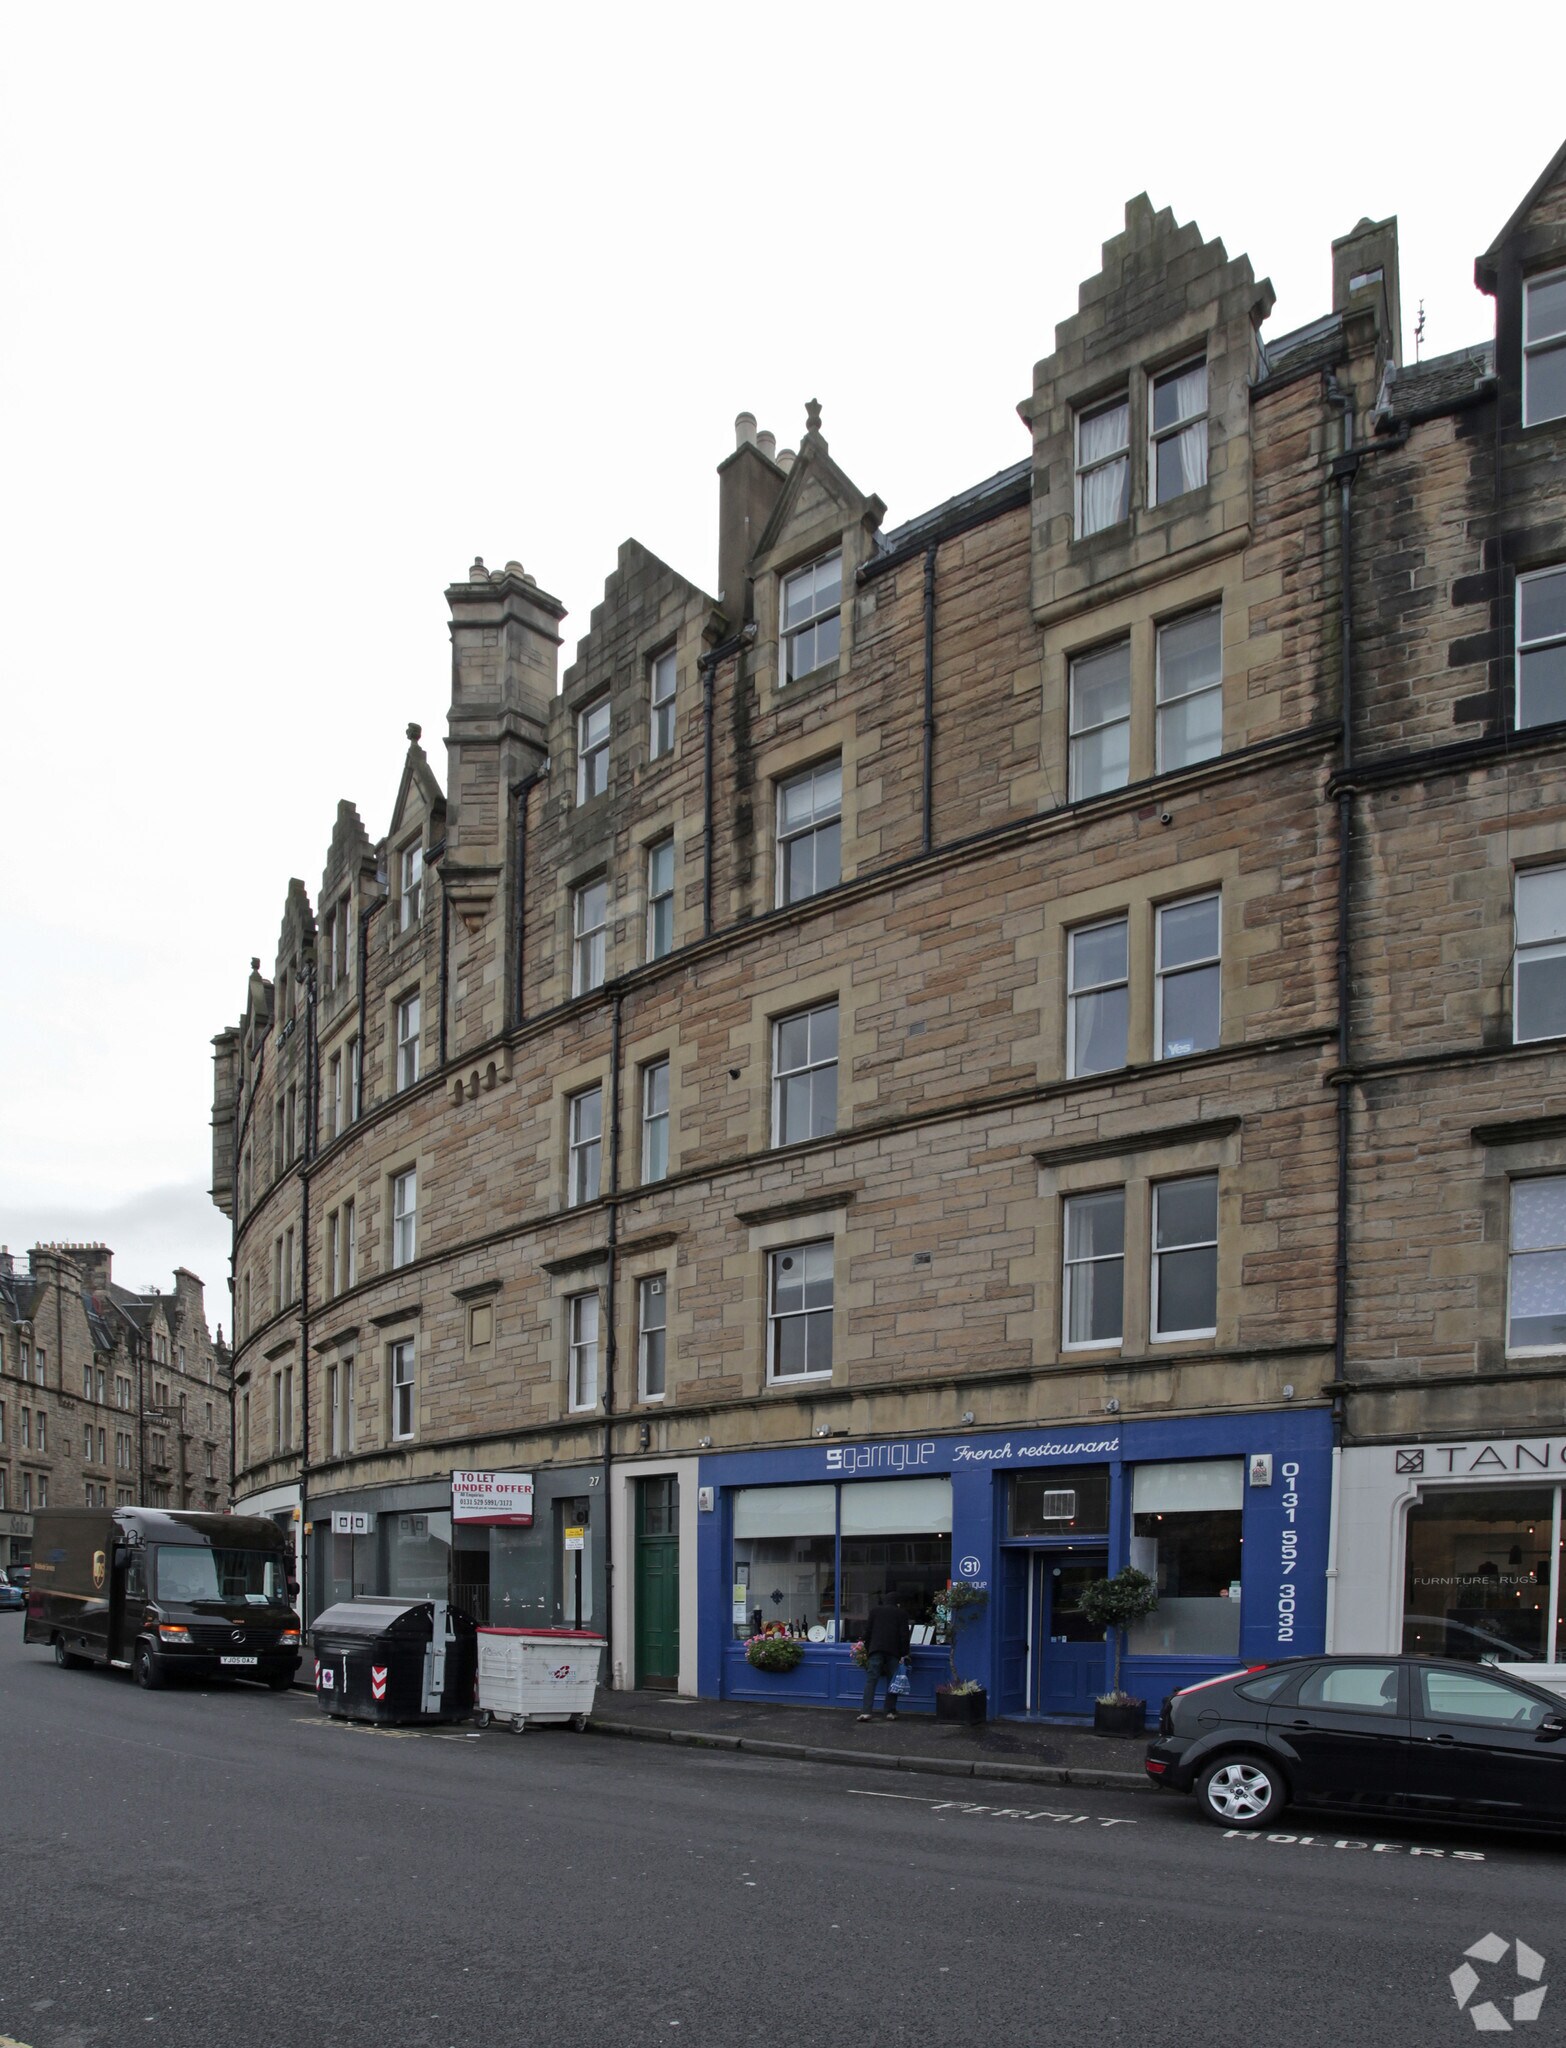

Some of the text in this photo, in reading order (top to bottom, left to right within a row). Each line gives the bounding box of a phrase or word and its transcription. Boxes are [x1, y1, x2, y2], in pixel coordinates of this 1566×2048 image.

[826, 1442, 936, 1474] LA garrigue
[952, 1437, 1120, 1462] French restaurant
[461, 1473, 495, 1483] TO LET
[589, 1476, 600, 1487] 27
[454, 1484, 532, 1493] UNDER OFFER
[1277, 1462, 1300, 1642] 0131 557 3032
[963, 1561, 977, 1573] 31
[1413, 1575, 1538, 1585] FURNITURE RUGS
[931, 1801, 1137, 1827] PERMIT
[1221, 1830, 1487, 1862] HOLDERS
